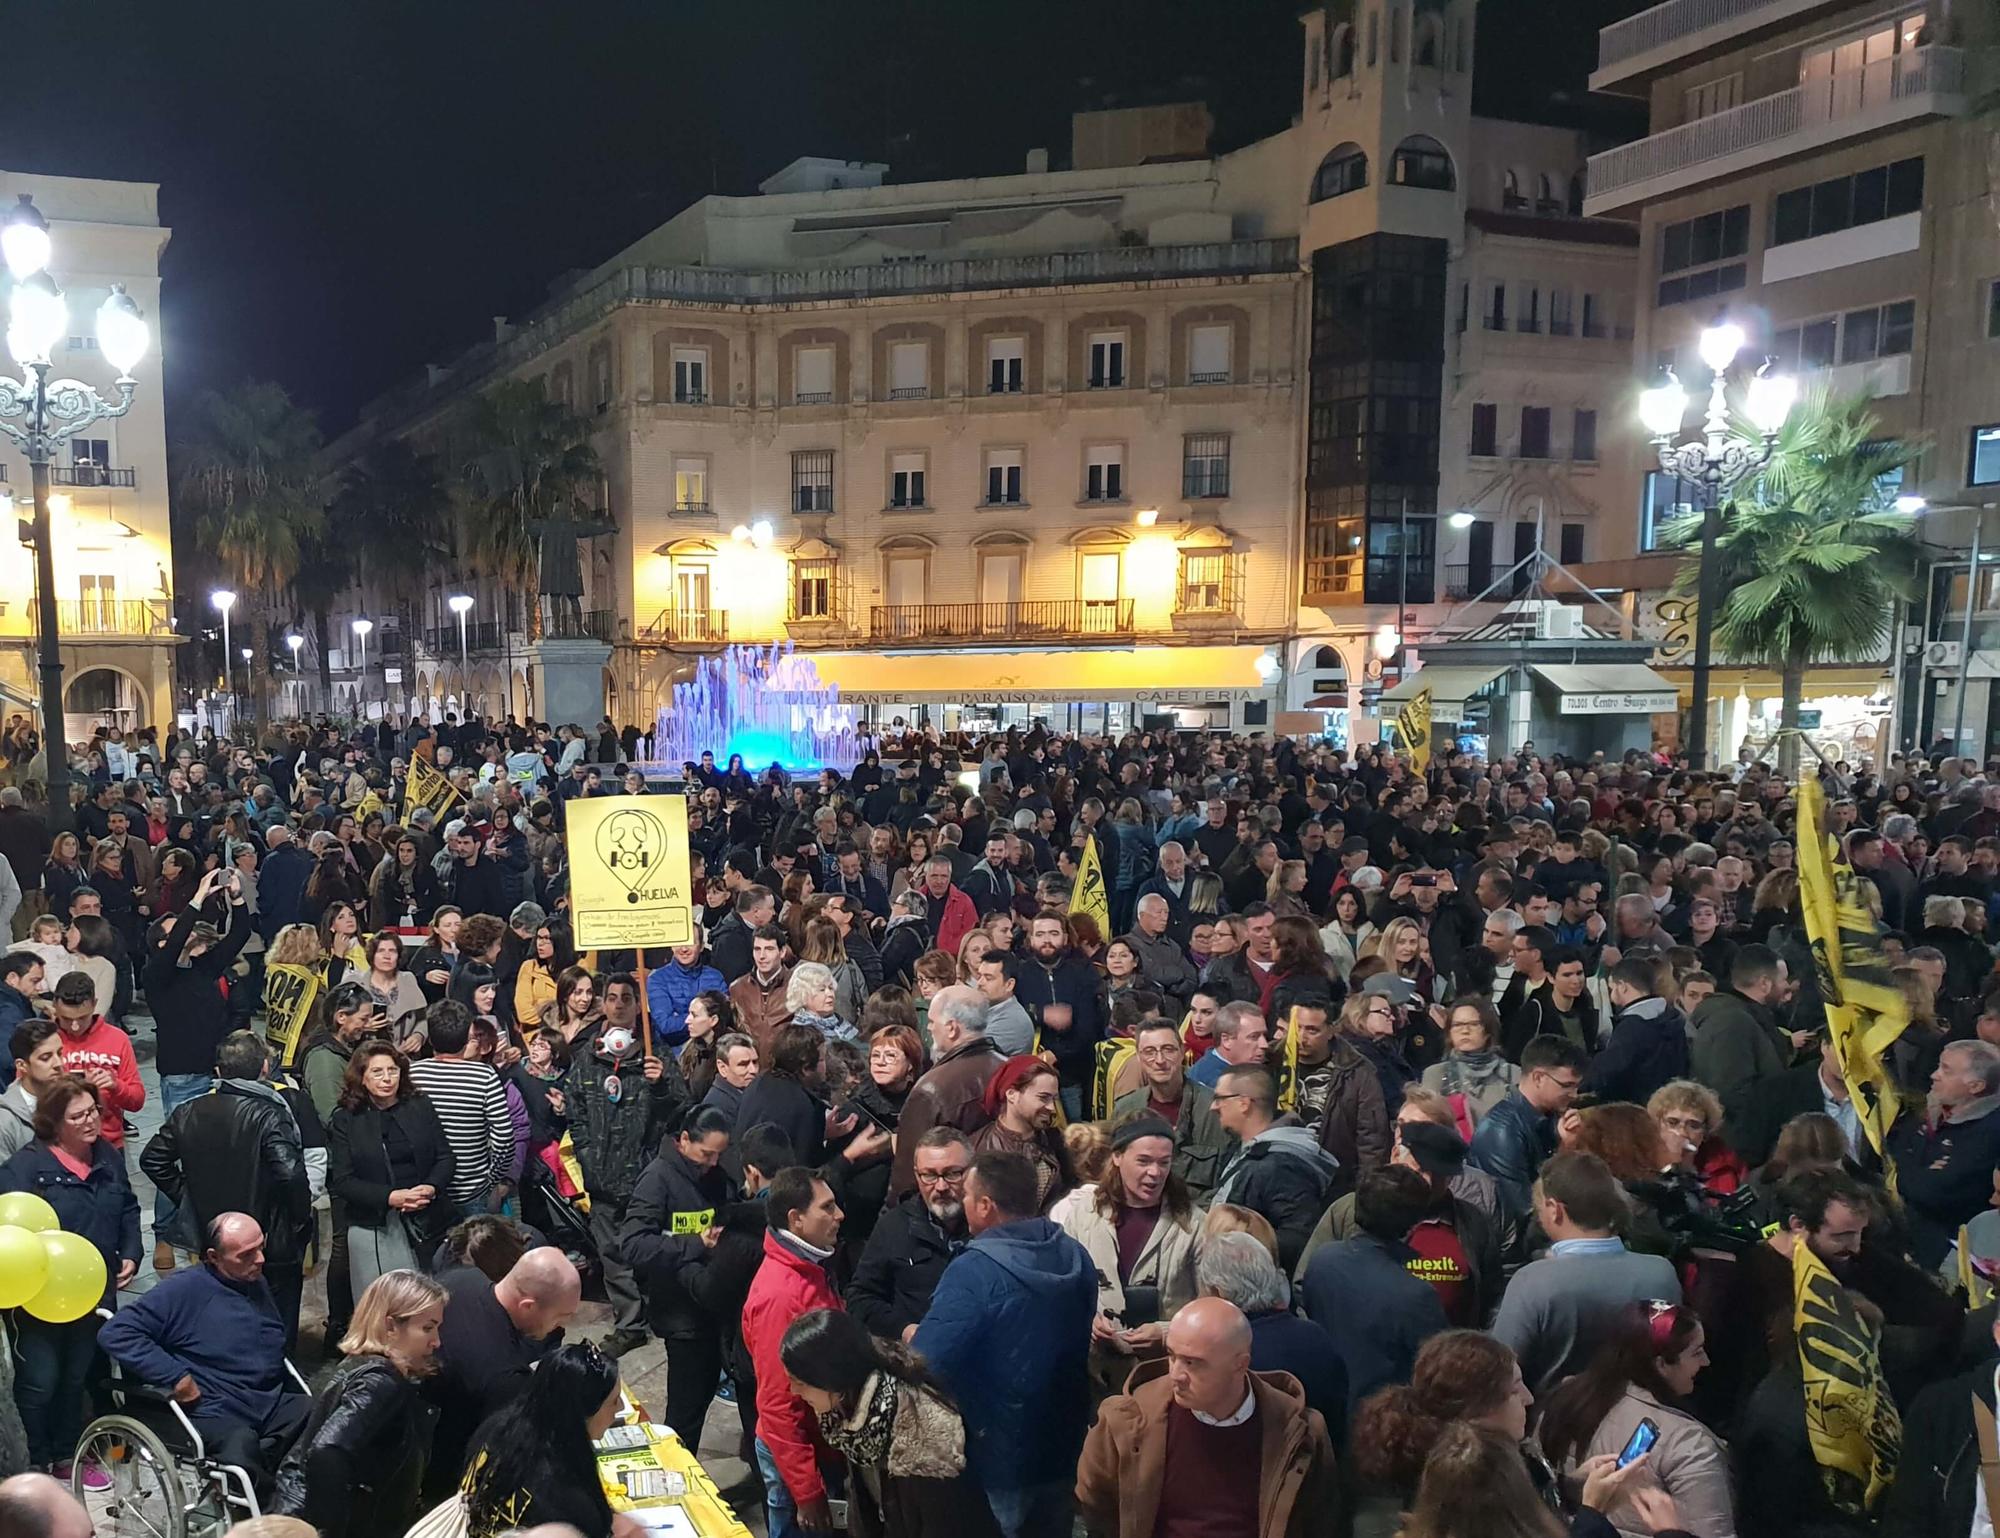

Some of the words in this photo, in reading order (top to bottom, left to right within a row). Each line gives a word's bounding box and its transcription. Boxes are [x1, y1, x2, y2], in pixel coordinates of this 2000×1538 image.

[1568, 697, 1588, 709] TOLDOS
[1592, 695, 1619, 709] Centro
[640, 888, 679, 902] HUELVA
[675, 1215, 688, 1227] NO
